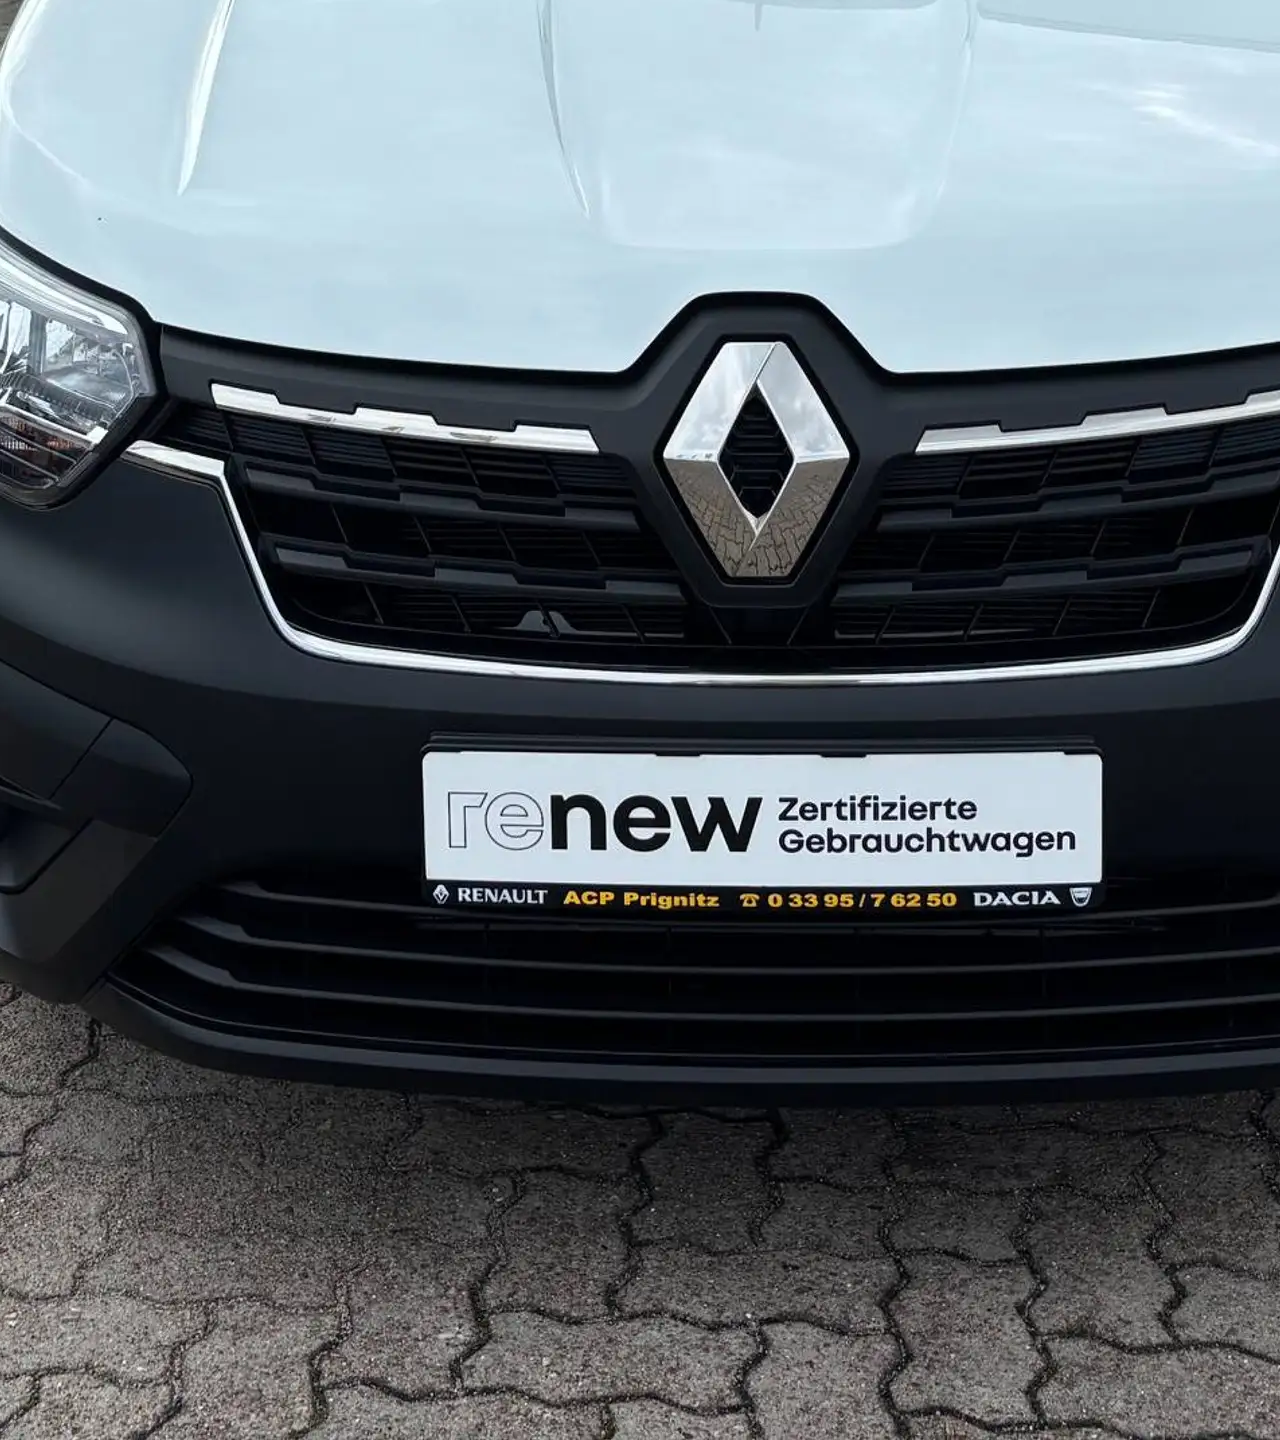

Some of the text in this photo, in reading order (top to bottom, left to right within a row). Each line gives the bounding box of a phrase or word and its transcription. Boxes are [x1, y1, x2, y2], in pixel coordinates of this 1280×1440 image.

[446, 790, 763, 853] renew
[777, 794, 979, 823] Zertifizierte
[777, 826, 1076, 858] Gebrauchtwagen
[457, 887, 549, 905] RENAULT
[563, 890, 616, 906] ACP
[623, 891, 720, 910] Prignitz
[767, 893, 783, 908] 0
[788, 893, 819, 908] 33
[823, 893, 855, 908] 95
[870, 893, 885, 908] 7
[890, 893, 922, 908] 62
[926, 892, 958, 907] 50
[972, 890, 1062, 907] DACIA
